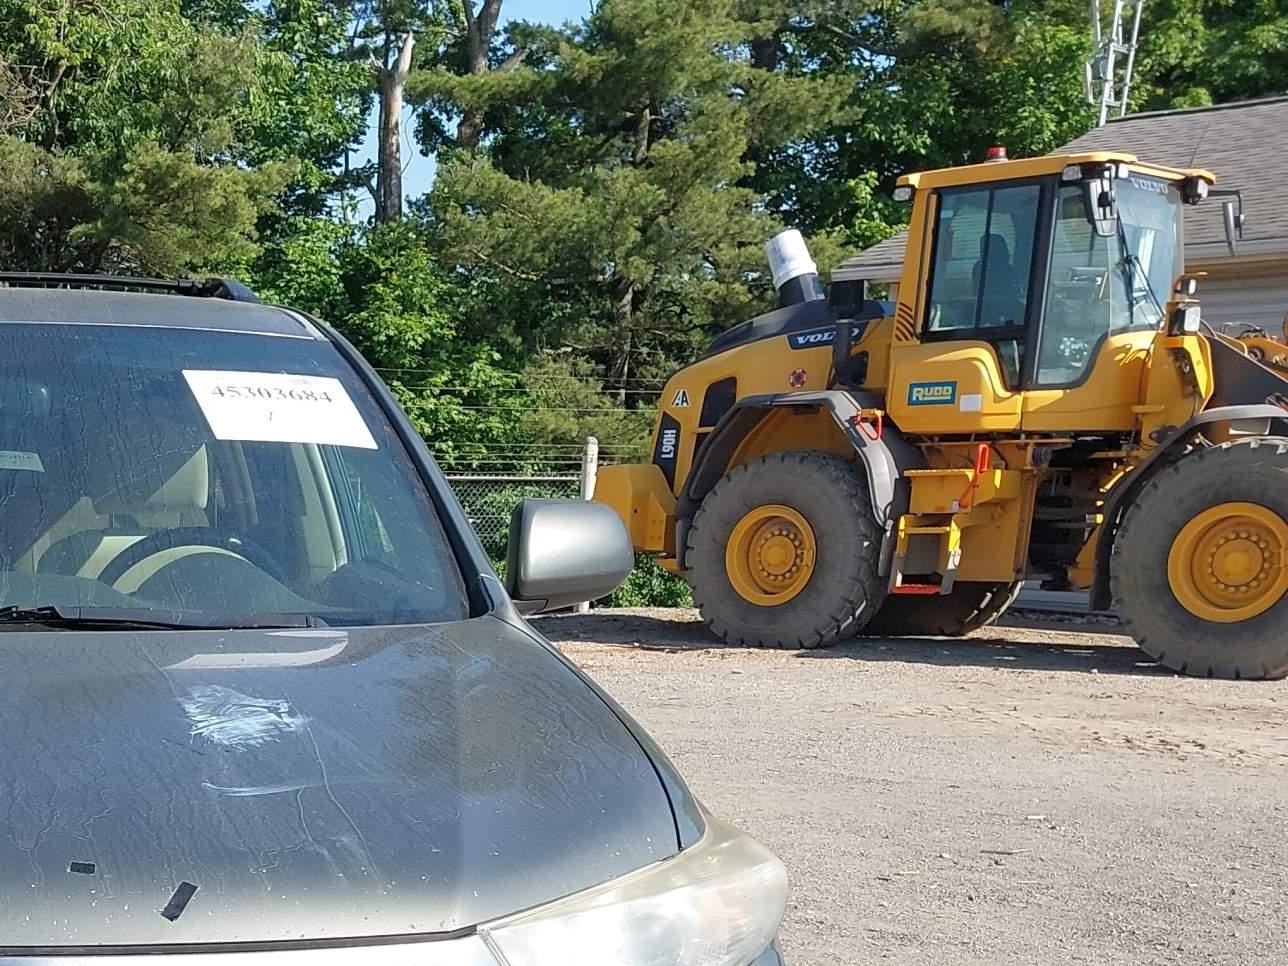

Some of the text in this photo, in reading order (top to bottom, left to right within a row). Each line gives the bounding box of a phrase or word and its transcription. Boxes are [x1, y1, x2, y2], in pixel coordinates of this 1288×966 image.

[1130, 177, 1169, 194] VOLVO
[212, 385, 332, 402] 45303684
[912, 386, 953, 401] RUDD
[661, 430, 677, 458] L90H
